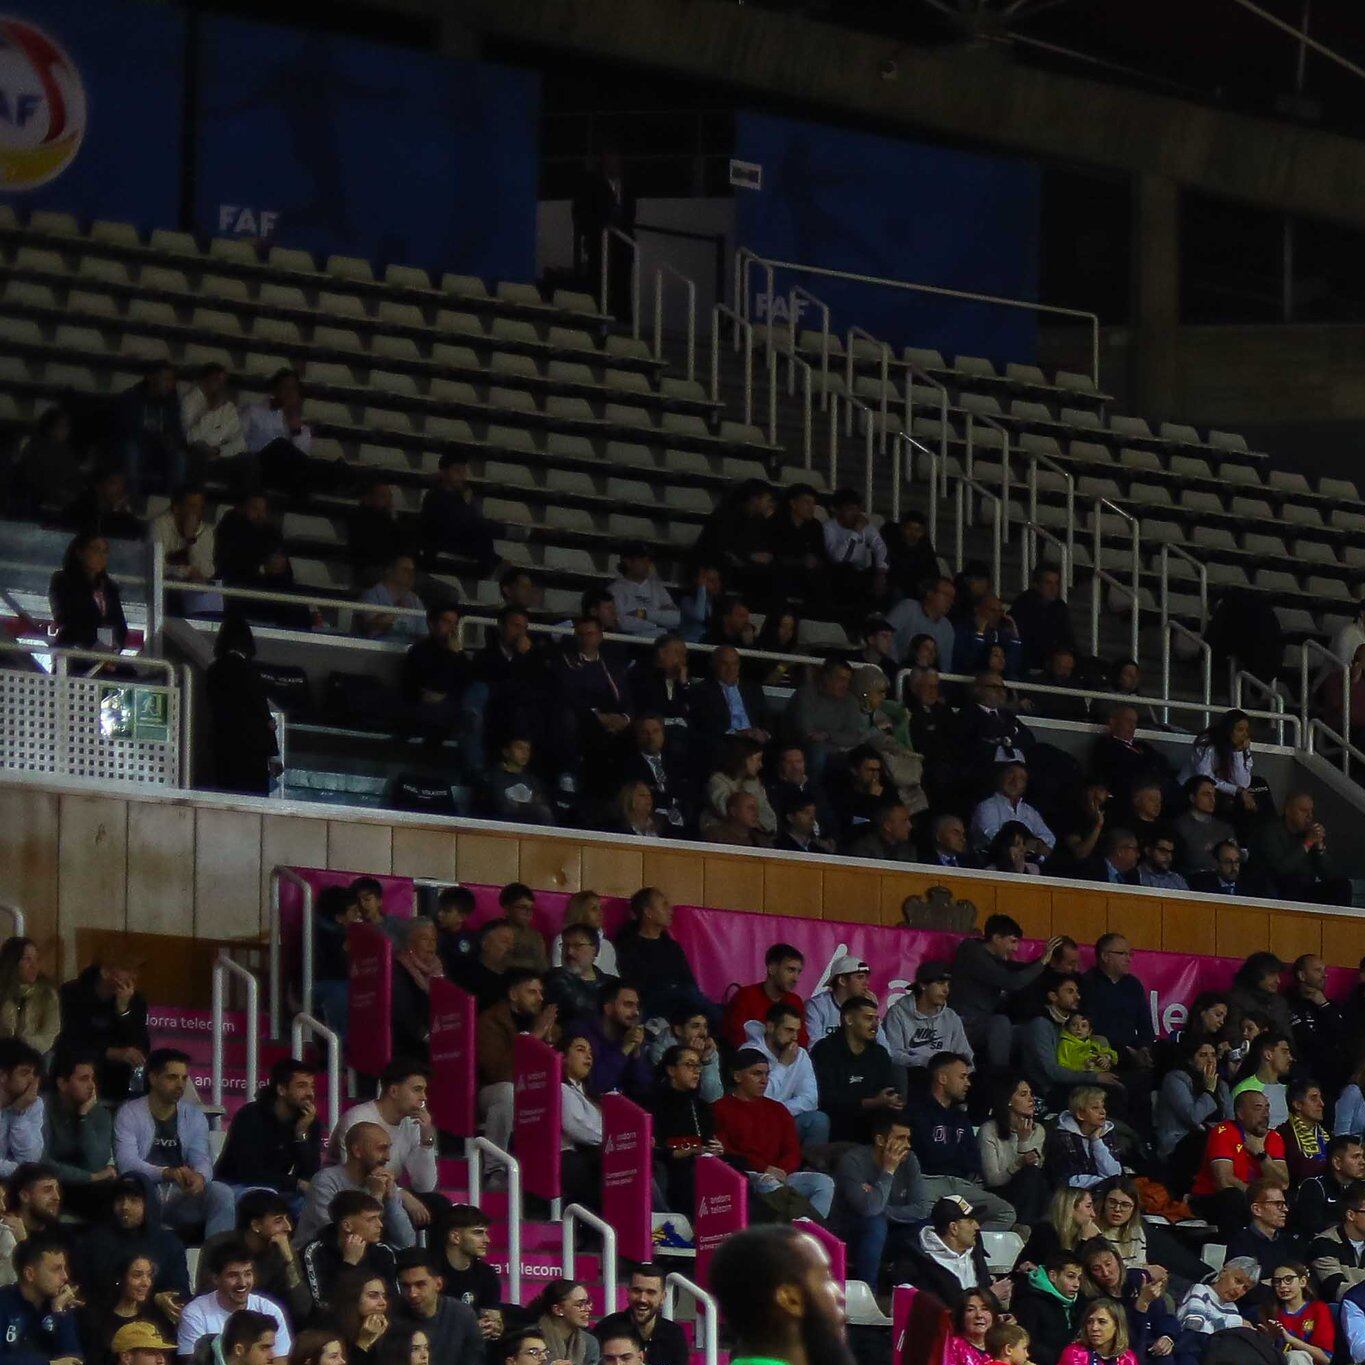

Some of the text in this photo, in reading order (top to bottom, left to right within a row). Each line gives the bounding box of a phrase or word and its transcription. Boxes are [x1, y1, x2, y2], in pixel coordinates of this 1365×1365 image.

[218, 203, 280, 237] FAF
[181, 1016, 235, 1032] telecm
[506, 1263, 563, 1277] tlecom
[6, 1325, 17, 1343] 6
